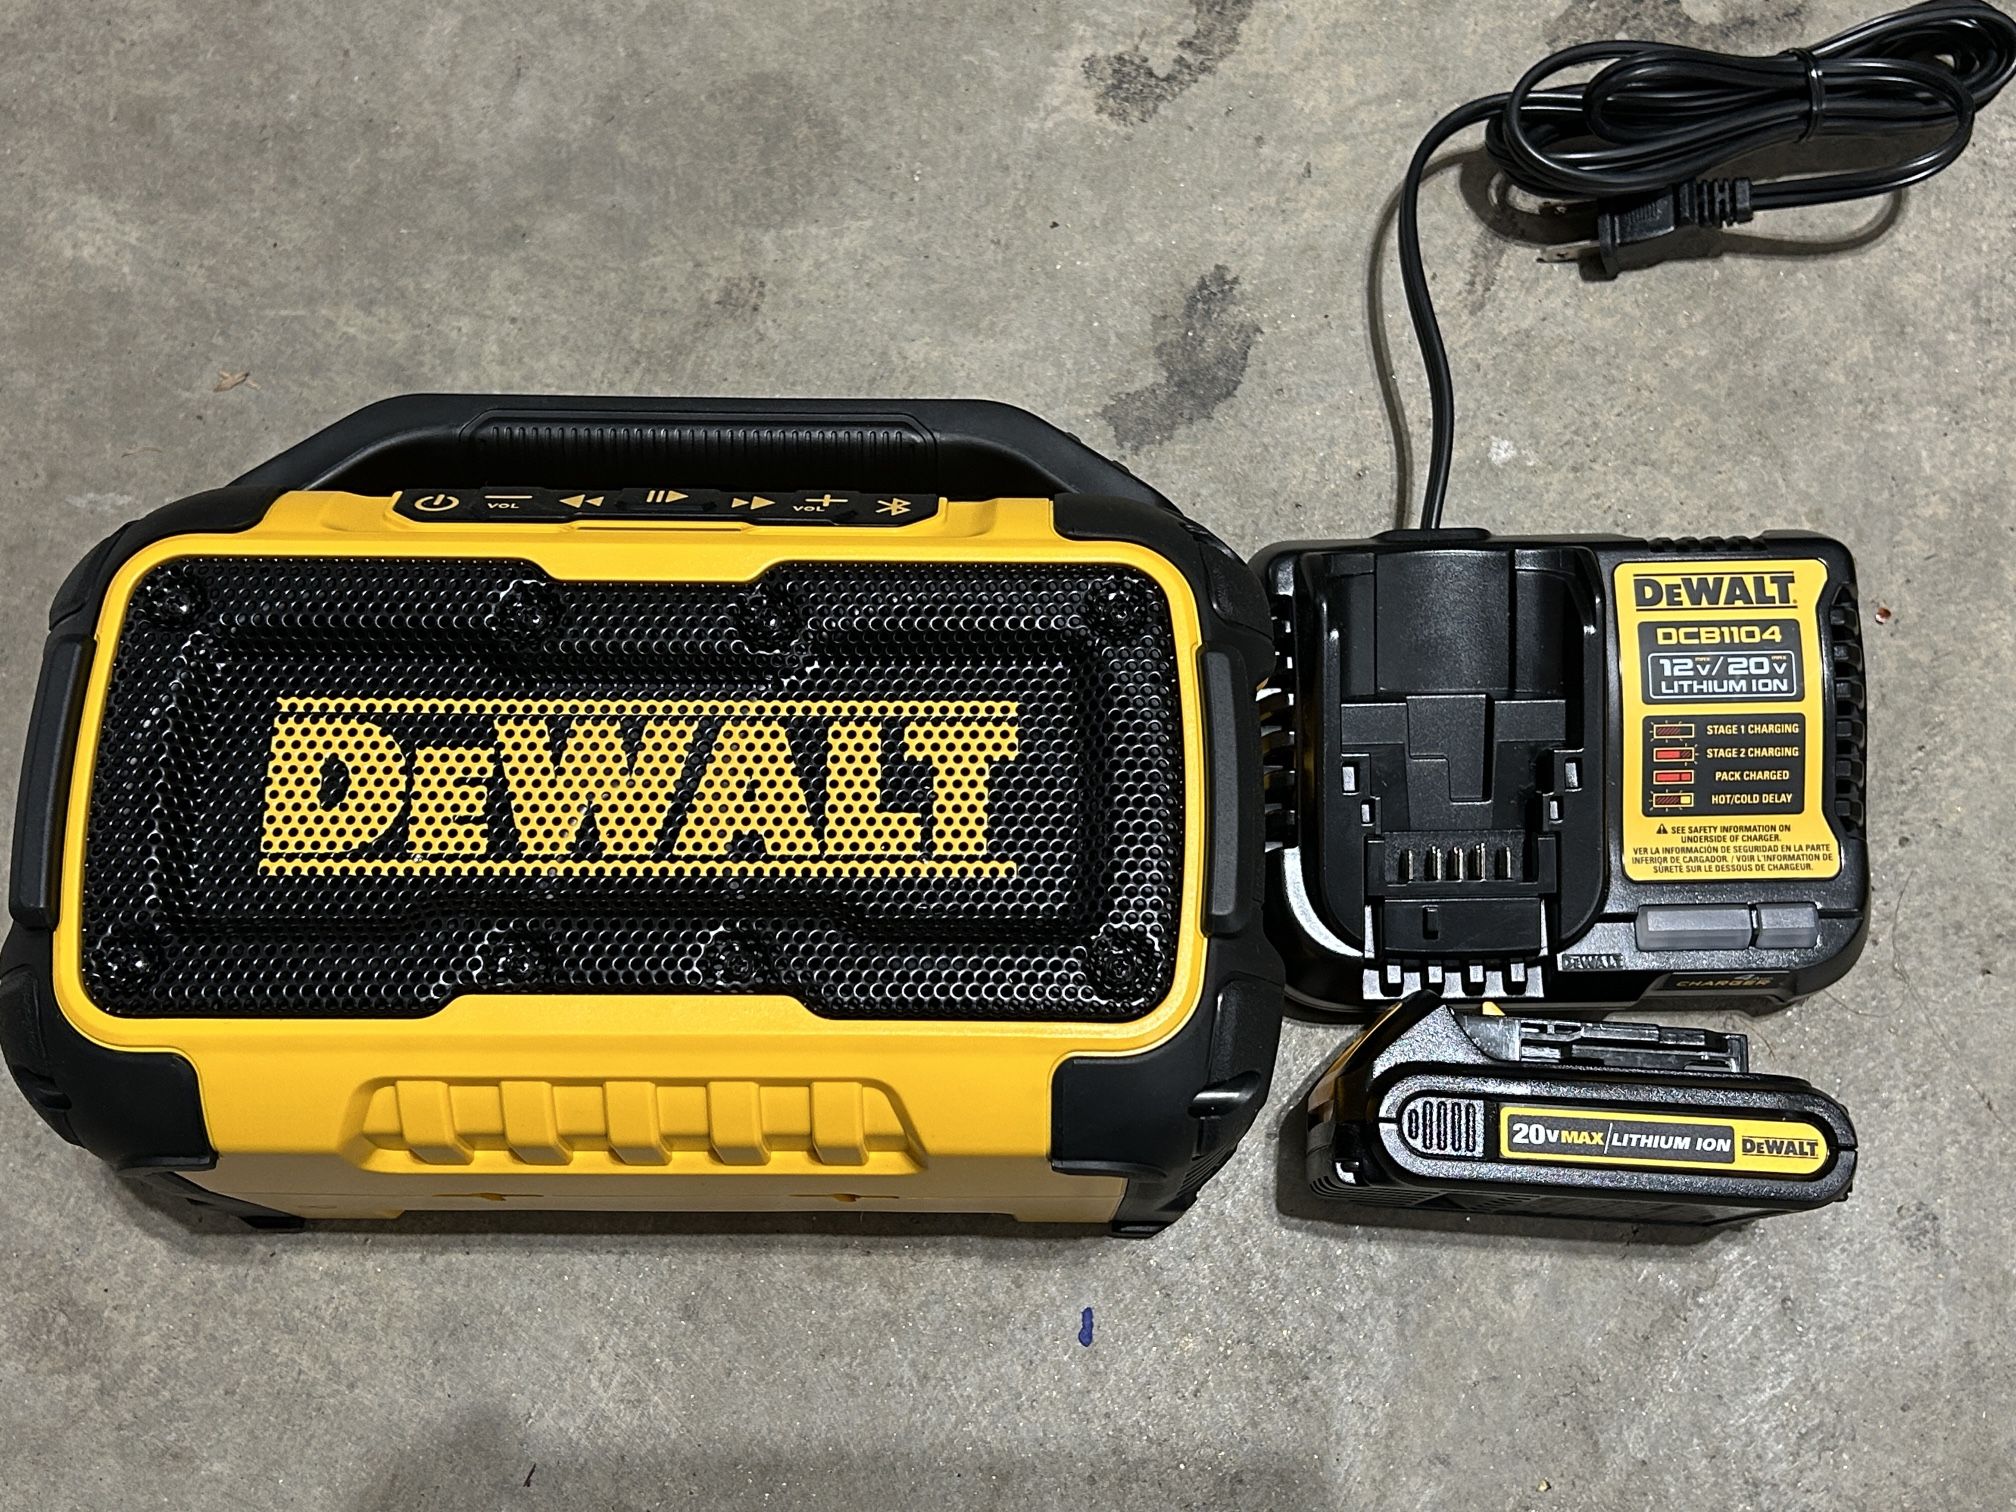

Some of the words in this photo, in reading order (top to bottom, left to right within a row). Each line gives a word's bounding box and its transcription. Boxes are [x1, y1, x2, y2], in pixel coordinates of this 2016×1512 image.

[487, 502, 520, 510] VOL
[793, 505, 825, 513] VOL
[1656, 625, 1782, 646] DCB1104
[1661, 679, 1747, 694] LITHIUM
[1752, 678, 1788, 693] ION
[1706, 724, 1738, 735] STAGE
[1740, 724, 1745, 735] 1
[1748, 723, 1799, 734] CHARGING
[1706, 748, 1738, 759] STAGE
[1739, 748, 1746, 758] 2
[1747, 747, 1799, 758] CHARGING
[1715, 771, 1741, 781] PACK
[1743, 770, 1790, 781] CHARGED
[1711, 794, 1760, 805] HOT/COLD
[1761, 793, 1793, 804] DELAY
[1671, 826, 1686, 834] SEE
[1688, 826, 1718, 834] SAFETY
[1720, 825, 1777, 834] INFORMATION
[1779, 825, 1791, 833] ON
[1681, 835, 1727, 843] UNDERSIDE
[1729, 834, 1740, 843] OF
[1741, 834, 1782, 842] CHARGER.
[1633, 847, 1648, 855] VER
[1650, 847, 1660, 855] LA
[1721, 846, 1731, 854] DE
[1733, 845, 1779, 853] SEGURIDAD
[1781, 844, 1791, 852] EN
[1794, 844, 1804, 852] LA
[1805, 844, 1831, 852] PARTE
[1670, 856, 1681, 864] DE
[1822, 853, 1833, 861] DE
[1686, 865, 1702, 873] SUR
[1715, 864, 1753, 872] DESSOUS
[1755, 864, 1765, 872] DE
[1611, 1132, 1691, 1150] LITHIUM
[1695, 1136, 1732, 1152] ION
